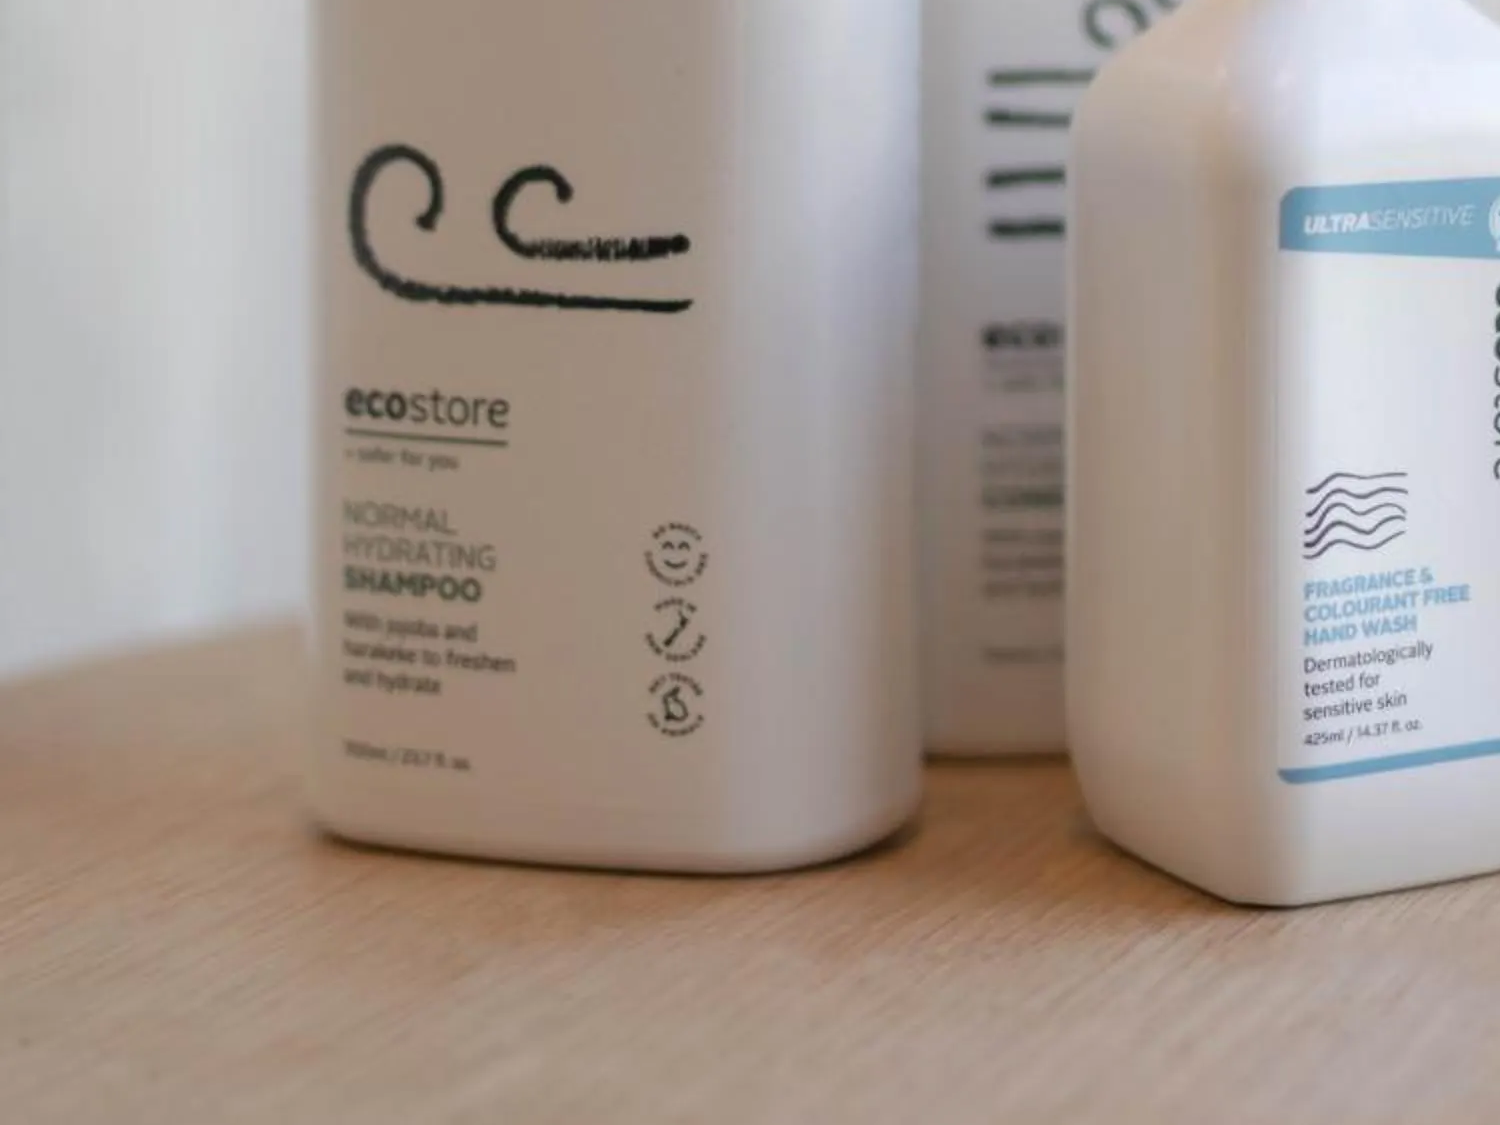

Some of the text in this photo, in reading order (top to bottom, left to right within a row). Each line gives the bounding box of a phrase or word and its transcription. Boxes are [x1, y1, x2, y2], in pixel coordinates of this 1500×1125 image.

[1303, 204, 1475, 235] ULTRASENSITIVE
[344, 387, 510, 428] ecostore
[343, 499, 457, 536] NORMAL
[343, 535, 497, 572] HYDRATING
[343, 565, 482, 603] SHAMPOO
[1303, 569, 1416, 601] FRAGRANCE
[1303, 584, 1471, 623] COLOURANT FREE
[1303, 614, 1418, 647] HAND WASH
[446, 649, 517, 673] freshen
[1303, 640, 1434, 674] Dermatologically
[377, 672, 442, 696] hydrate
[1304, 673, 1380, 698] tested for
[1303, 692, 1407, 721] sensitive skin
